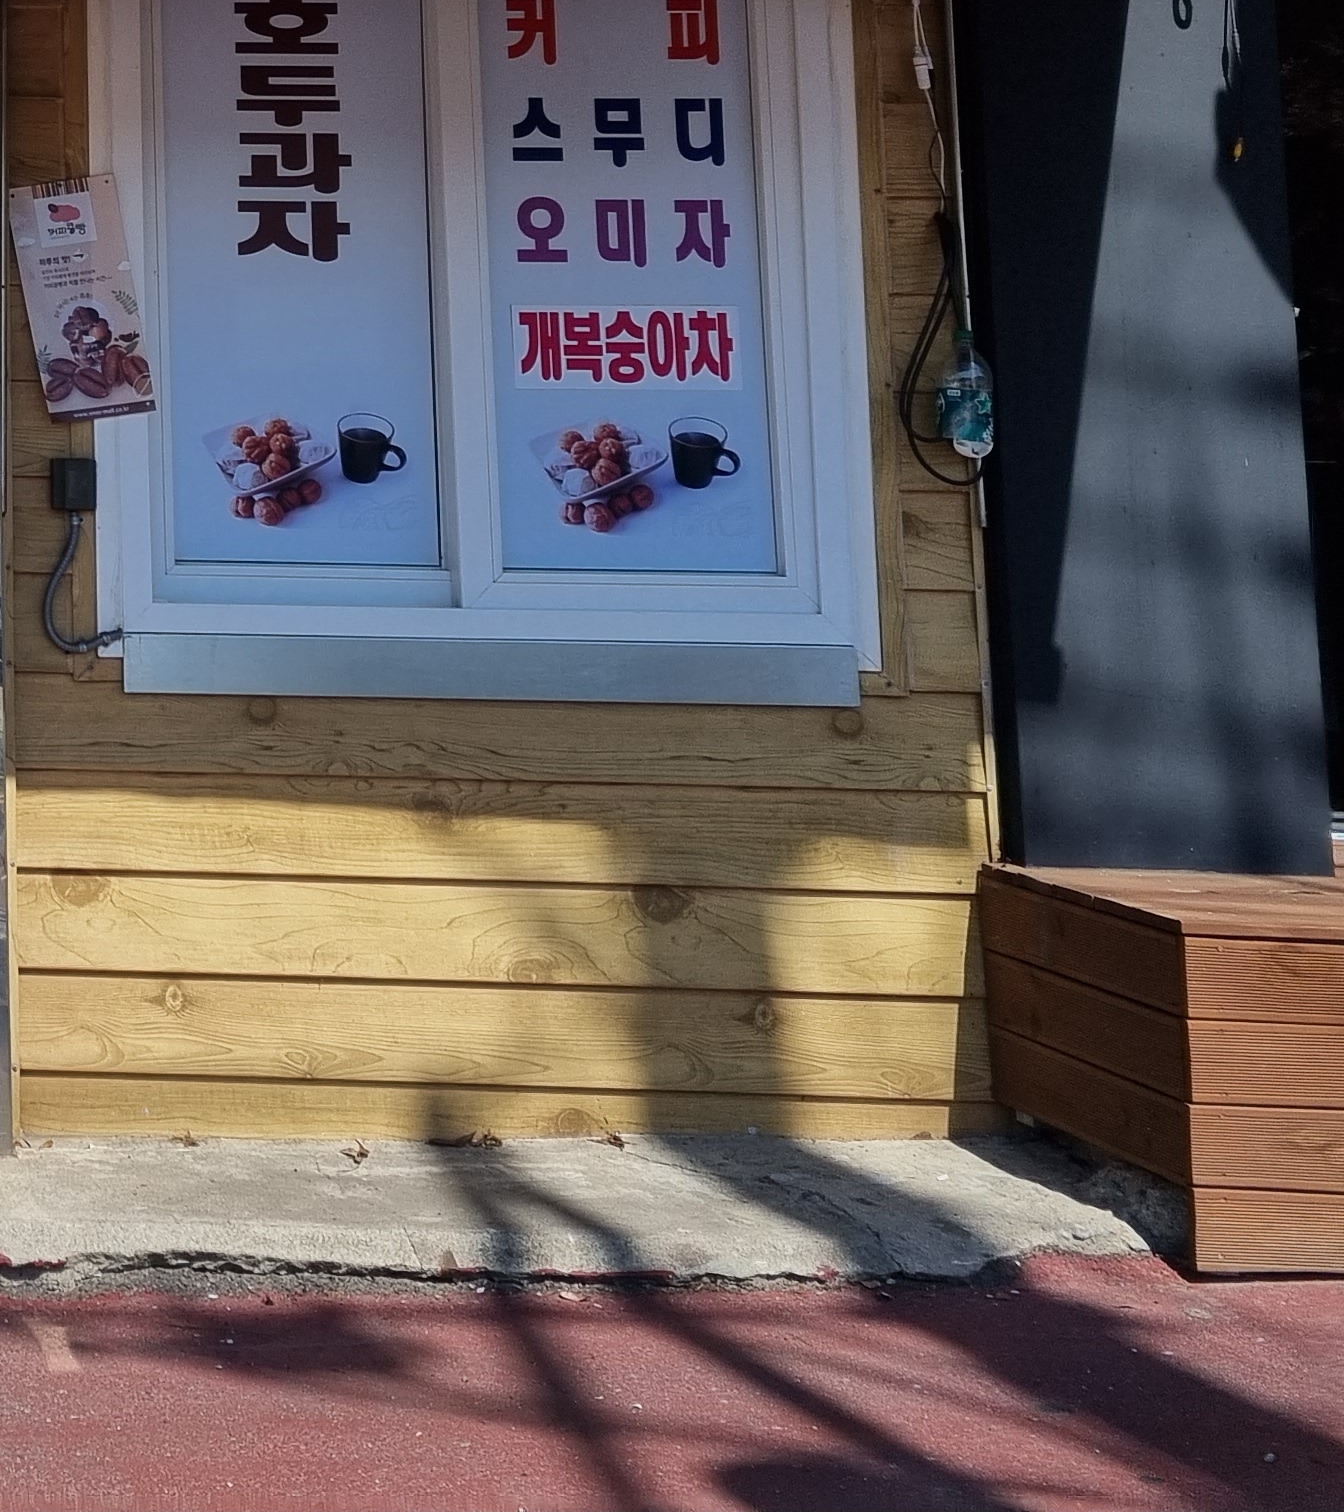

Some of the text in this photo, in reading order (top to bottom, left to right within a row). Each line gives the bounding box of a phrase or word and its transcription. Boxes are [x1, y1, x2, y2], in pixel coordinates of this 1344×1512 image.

[512, 97, 726, 167] 스무디
[516, 196, 731, 268] 오미자
[518, 310, 734, 384] 개복숭아차
